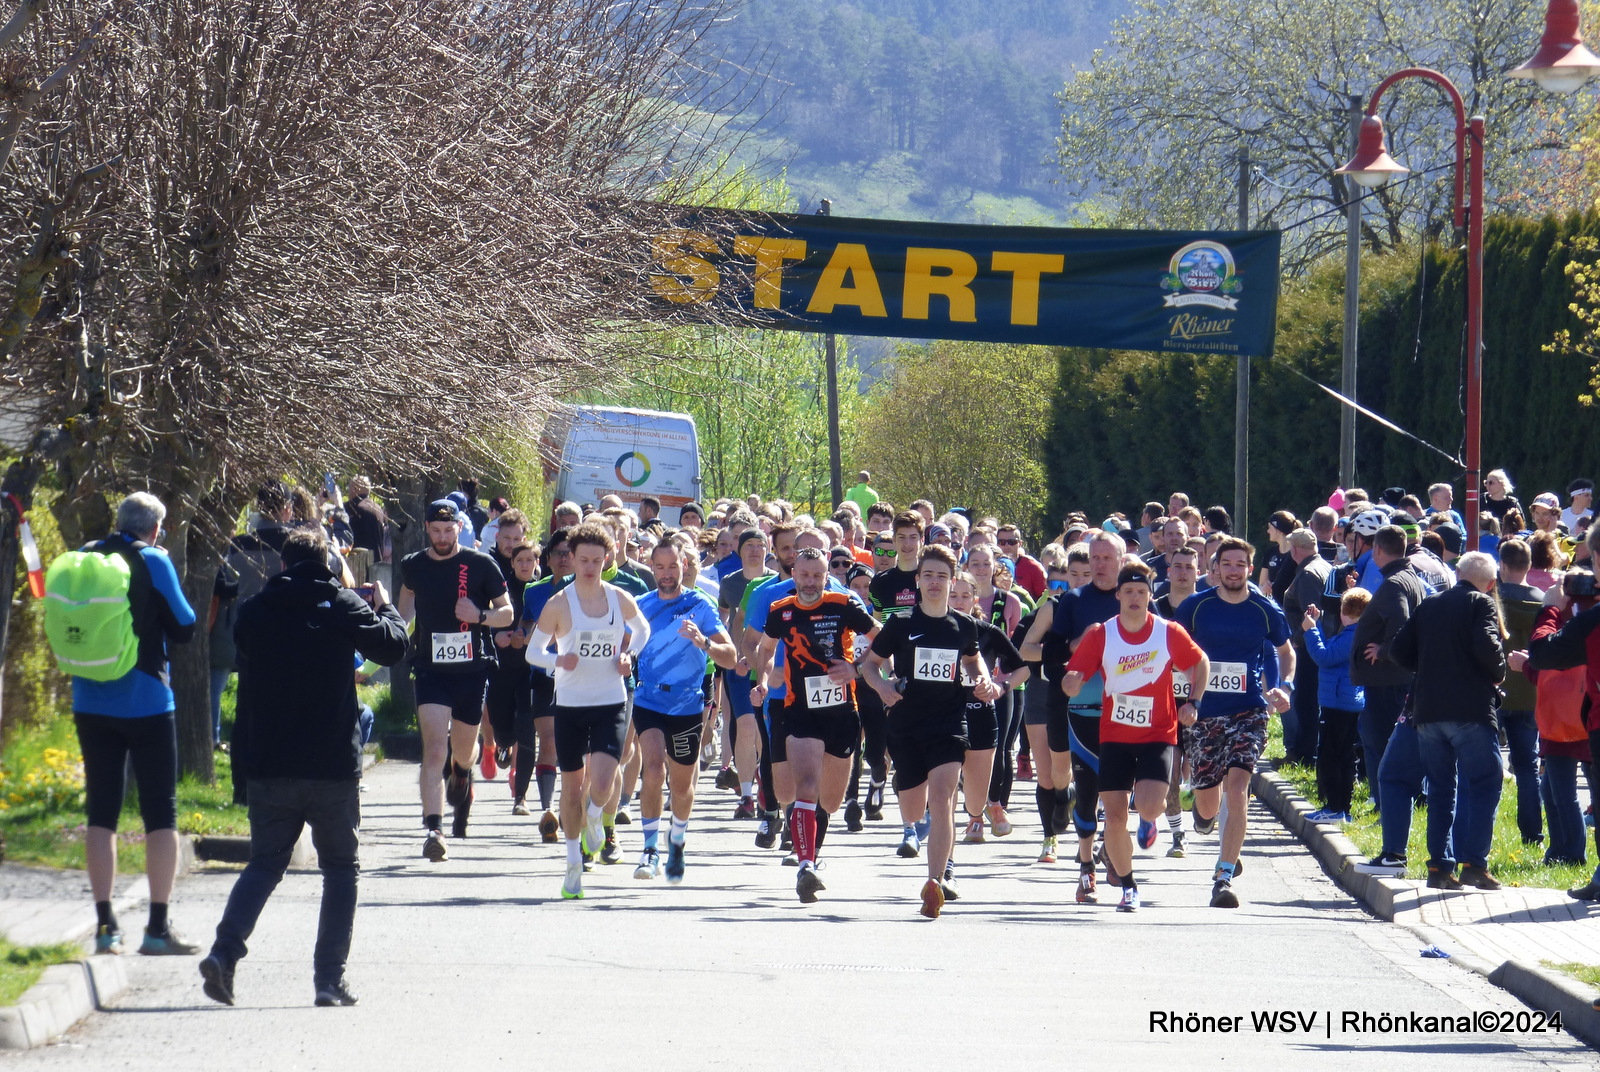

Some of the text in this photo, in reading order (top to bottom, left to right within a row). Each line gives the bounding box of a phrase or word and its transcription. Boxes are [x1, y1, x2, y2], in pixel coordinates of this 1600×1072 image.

[649, 230, 1065, 326] START
[1187, 278, 1216, 288] Bier
[1168, 313, 1235, 340] Rhöner
[1163, 340, 1239, 351] Bierspezialitäten
[458, 564, 469, 599] NIKE
[436, 645, 467, 660] 494
[580, 643, 612, 657] 528
[1118, 651, 1151, 665] DEXTRO
[1122, 657, 1150, 672] ENERGY
[919, 662, 951, 679] 468
[1209, 675, 1241, 690] 469
[811, 687, 843, 705] 475
[1116, 706, 1146, 724] 545
